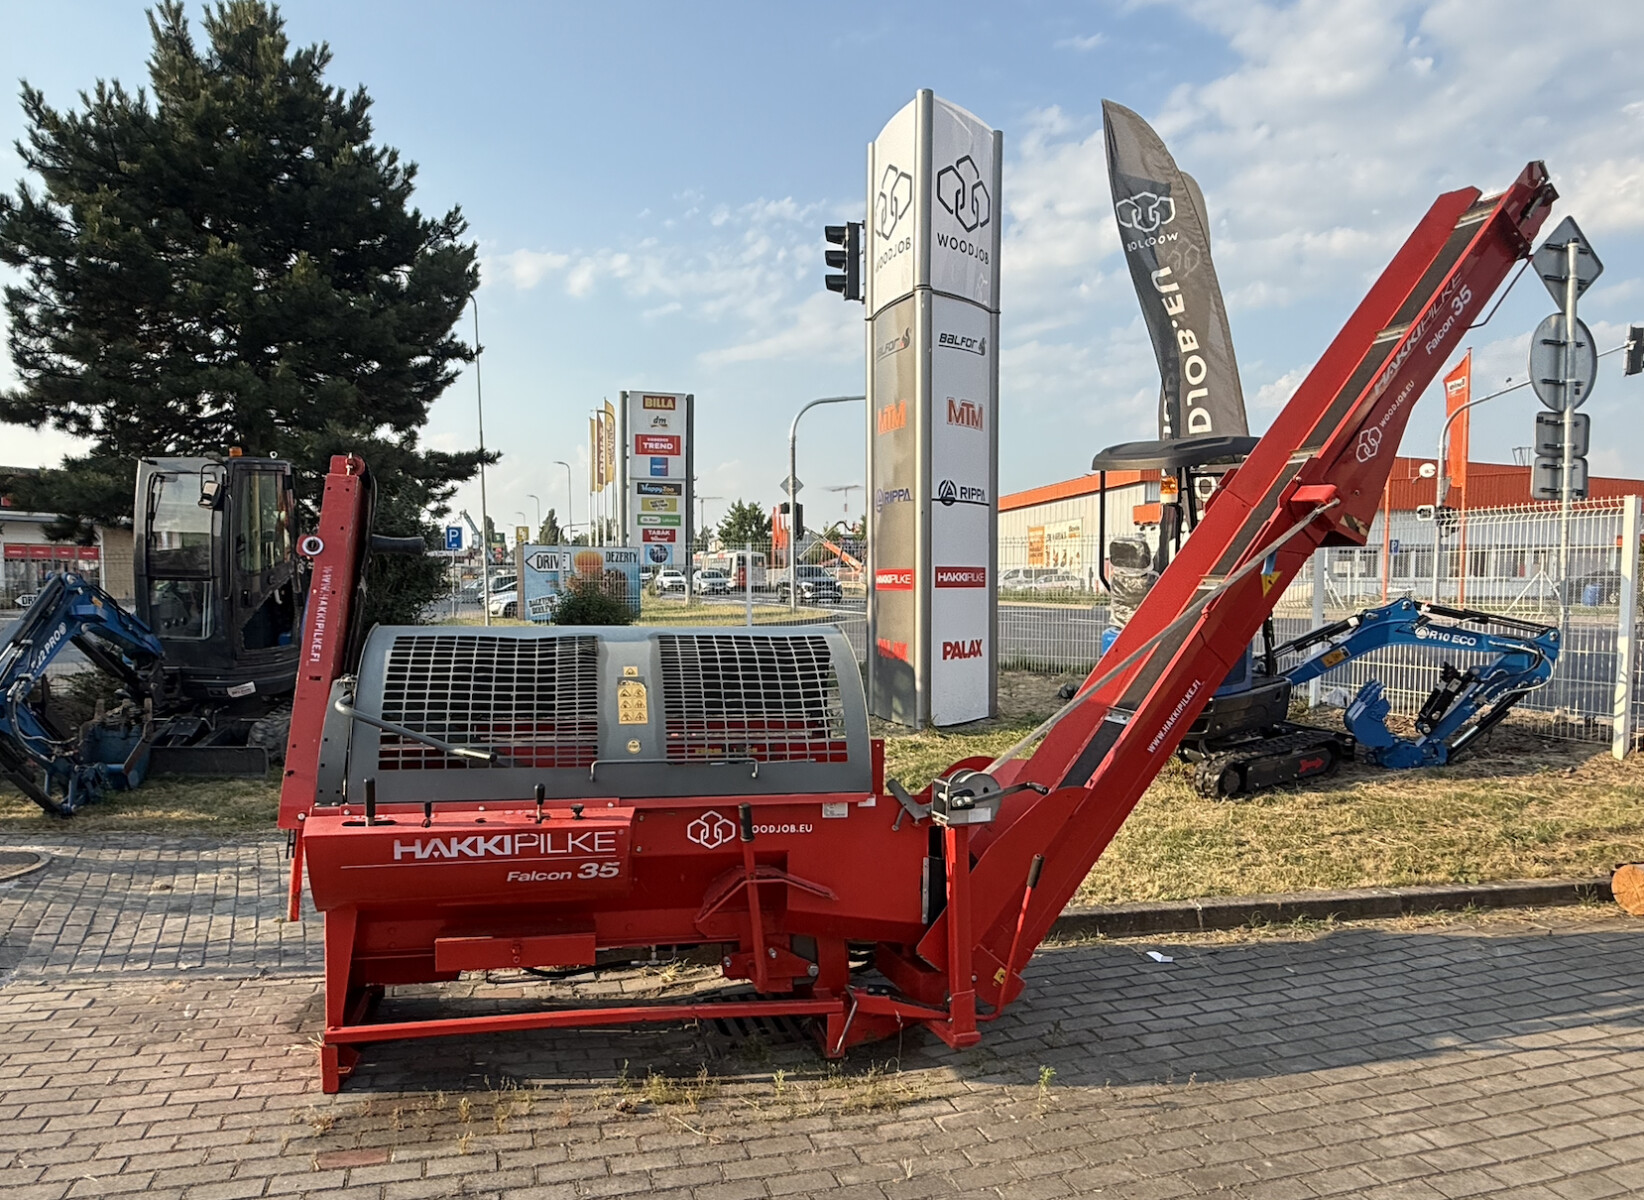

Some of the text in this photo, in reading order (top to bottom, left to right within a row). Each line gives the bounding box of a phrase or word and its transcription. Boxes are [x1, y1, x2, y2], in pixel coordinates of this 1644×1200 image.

[937, 232, 989, 266] WOODJOB
[1425, 284, 1473, 355] Falcon 35
[644, 397, 674, 409] BILLA
[1379, 380, 1415, 428] WOODJOB.EU
[653, 415, 667, 425] dm
[878, 399, 907, 435] MTM
[946, 396, 984, 432] MTM
[643, 442, 674, 450] TREND
[960, 486, 986, 502] RIPPA
[449, 529, 459, 542] P
[605, 551, 637, 563] DEZERTY
[44, 630, 61, 654] PRO
[1428, 630, 1477, 647] R10 ECO
[942, 639, 983, 660] PALAX
[1147, 679, 1201, 753] WWW.HAKKIPILKE.FI
[752, 823, 813, 834] OODJOB.EU
[393, 831, 616, 860] HAKKIPILKE
[507, 861, 620, 882] Falcon 35
